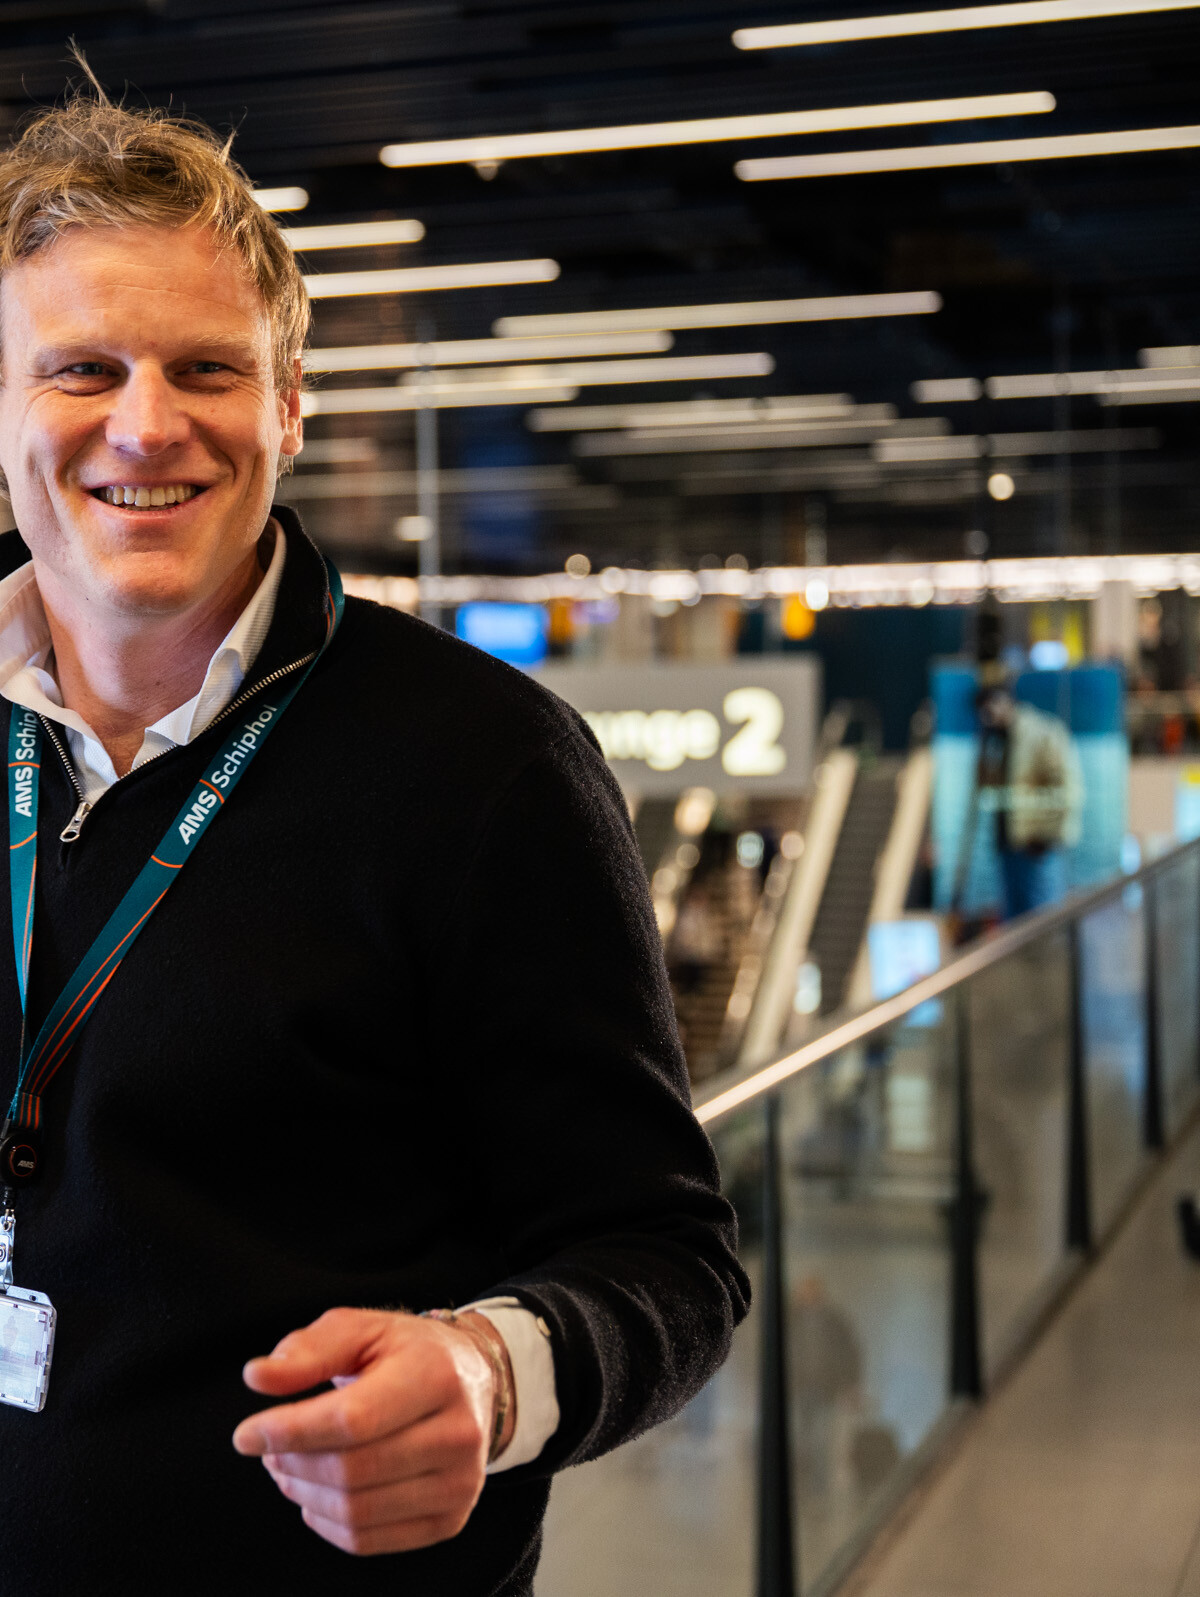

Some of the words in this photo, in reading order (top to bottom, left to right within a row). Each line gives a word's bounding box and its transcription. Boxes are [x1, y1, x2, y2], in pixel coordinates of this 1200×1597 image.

[722, 686, 786, 776] 2
[14, 766, 33, 818] AMS
[178, 790, 218, 845] AMS
[211, 703, 278, 789] Schiphol
[17, 1160, 34, 1168] AMS
